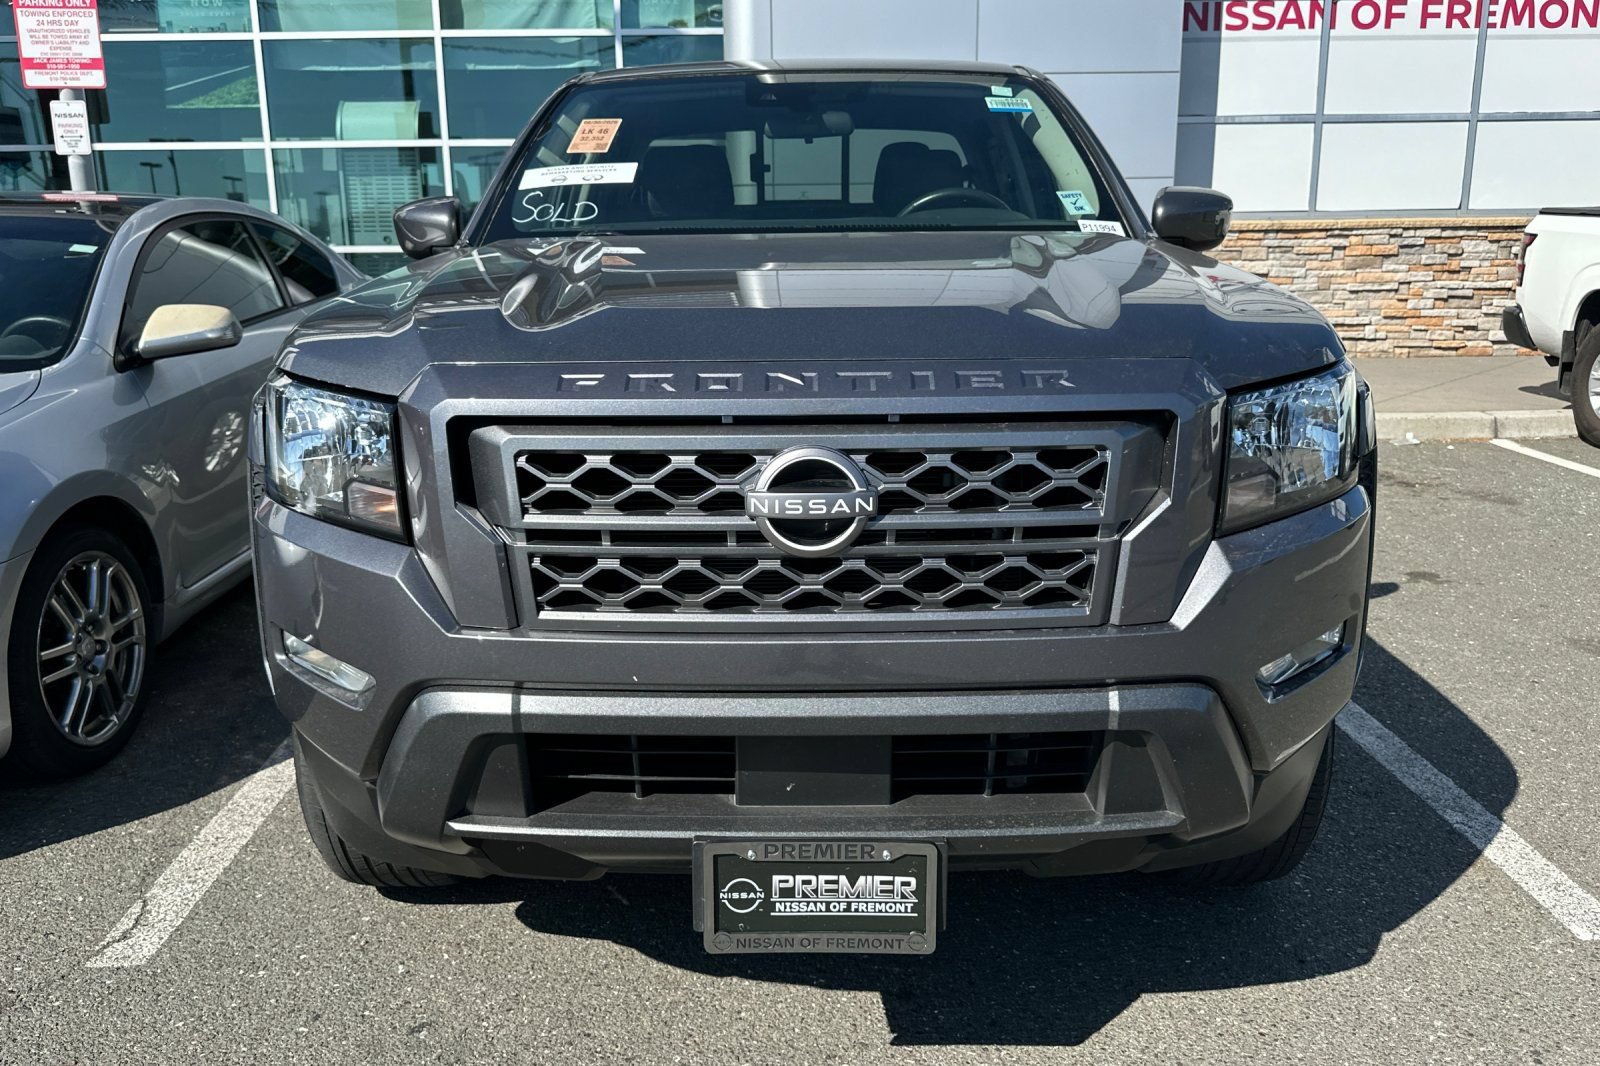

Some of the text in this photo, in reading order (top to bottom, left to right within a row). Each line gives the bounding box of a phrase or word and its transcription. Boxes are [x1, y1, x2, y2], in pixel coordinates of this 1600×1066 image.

[1182, 0, 1338, 31] NISSAN
[1351, 0, 1408, 30] OF
[556, 369, 1077, 392] FRONTIER
[750, 496, 873, 514] NISSAN
[764, 843, 876, 860] PREMIER
[771, 874, 917, 900] PREMIER
[775, 902, 914, 913] NISSAN OF FREMONT
[736, 937, 795, 949] NISSAN
[800, 937, 820, 948] OF
[826, 937, 905, 949] FREMONT
